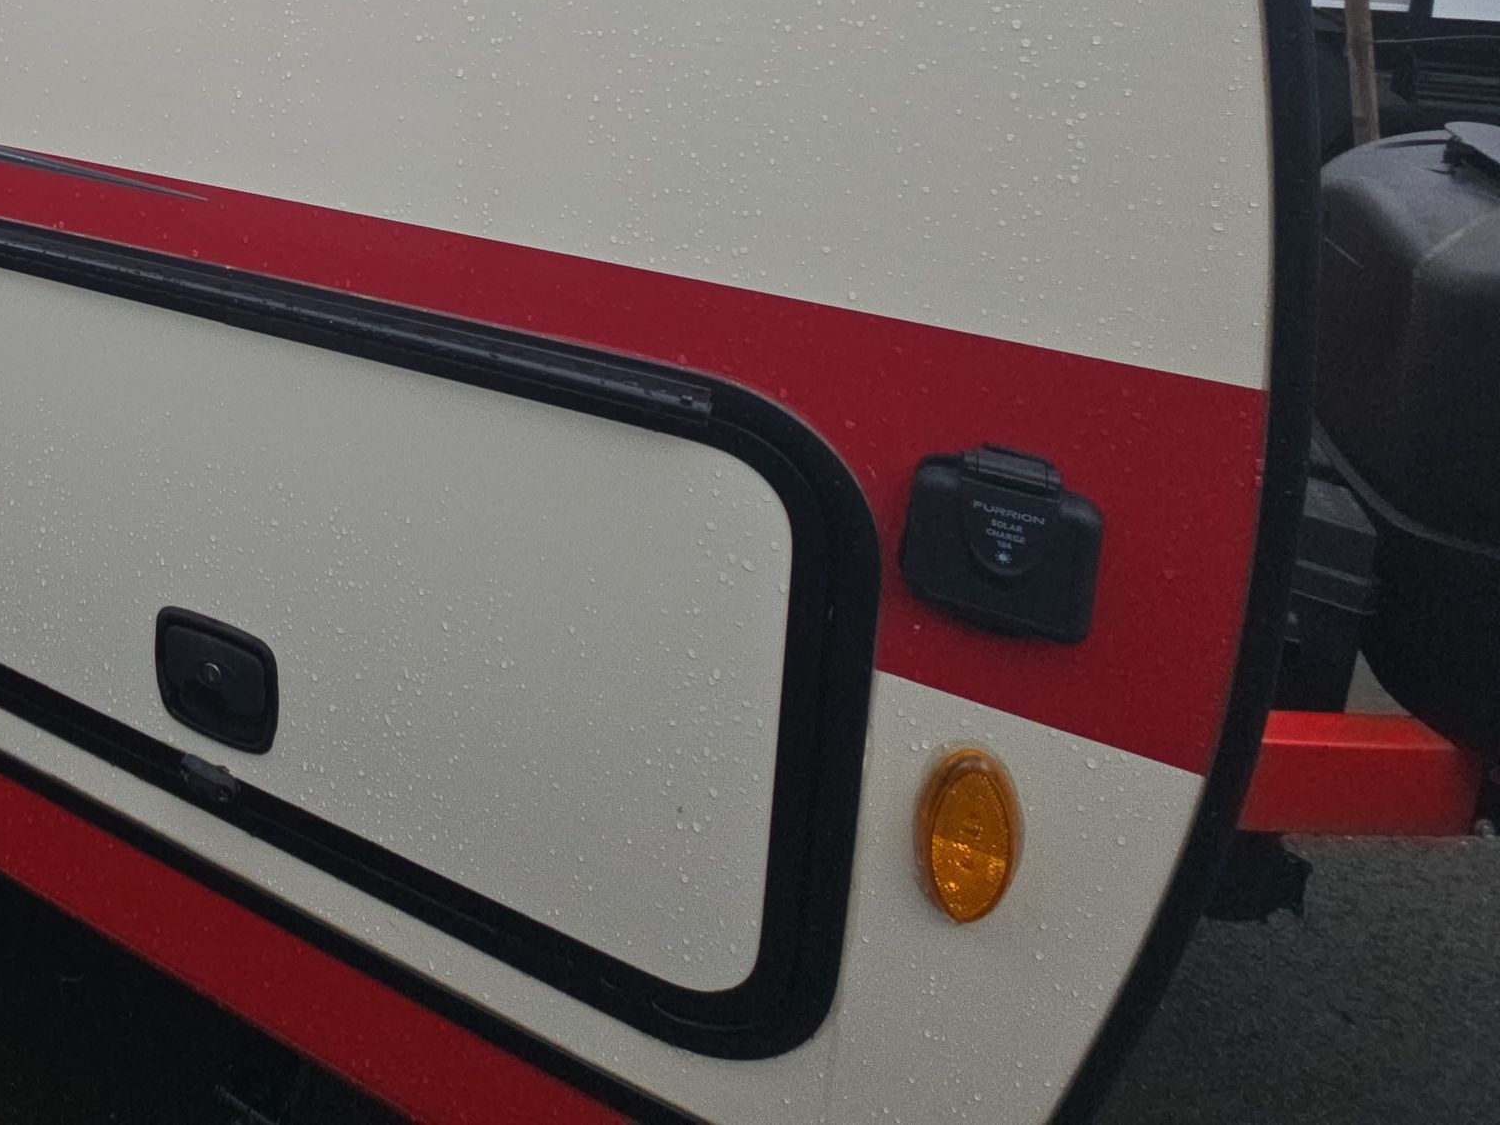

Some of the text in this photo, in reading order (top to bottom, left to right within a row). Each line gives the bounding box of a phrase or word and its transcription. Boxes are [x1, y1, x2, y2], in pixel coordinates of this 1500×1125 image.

[972, 499, 1045, 525] FURRION
[990, 518, 1024, 534] SOLAR
[986, 528, 1026, 545] CHARGE
